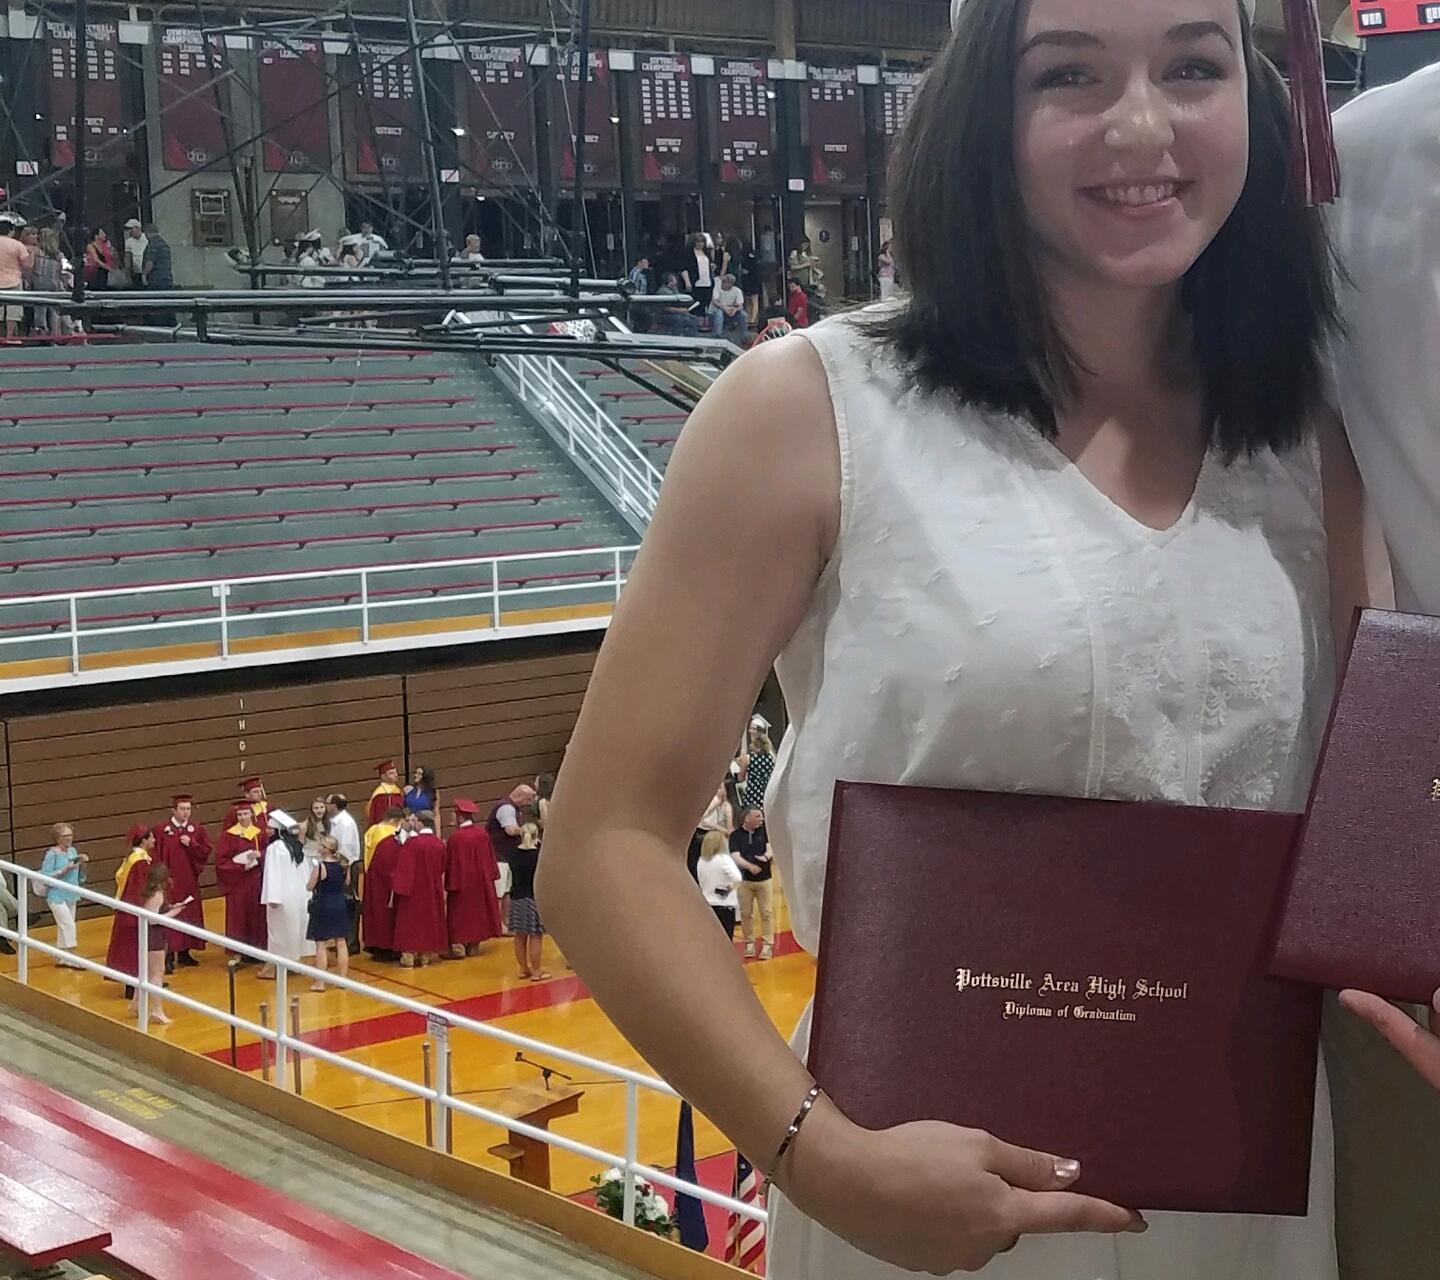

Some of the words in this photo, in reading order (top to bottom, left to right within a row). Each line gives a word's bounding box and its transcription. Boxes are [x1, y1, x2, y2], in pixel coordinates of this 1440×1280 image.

[1361, 11, 1382, 26] won
[955, 967, 1033, 992] Pottsville
[1038, 973, 1079, 997] Area
[1085, 975, 1126, 1001] High
[1132, 978, 1189, 1003] School
[1002, 1001, 1052, 1019] Diploma
[1057, 1004, 1070, 1018] of
[1073, 1005, 1137, 1022] Graduation
